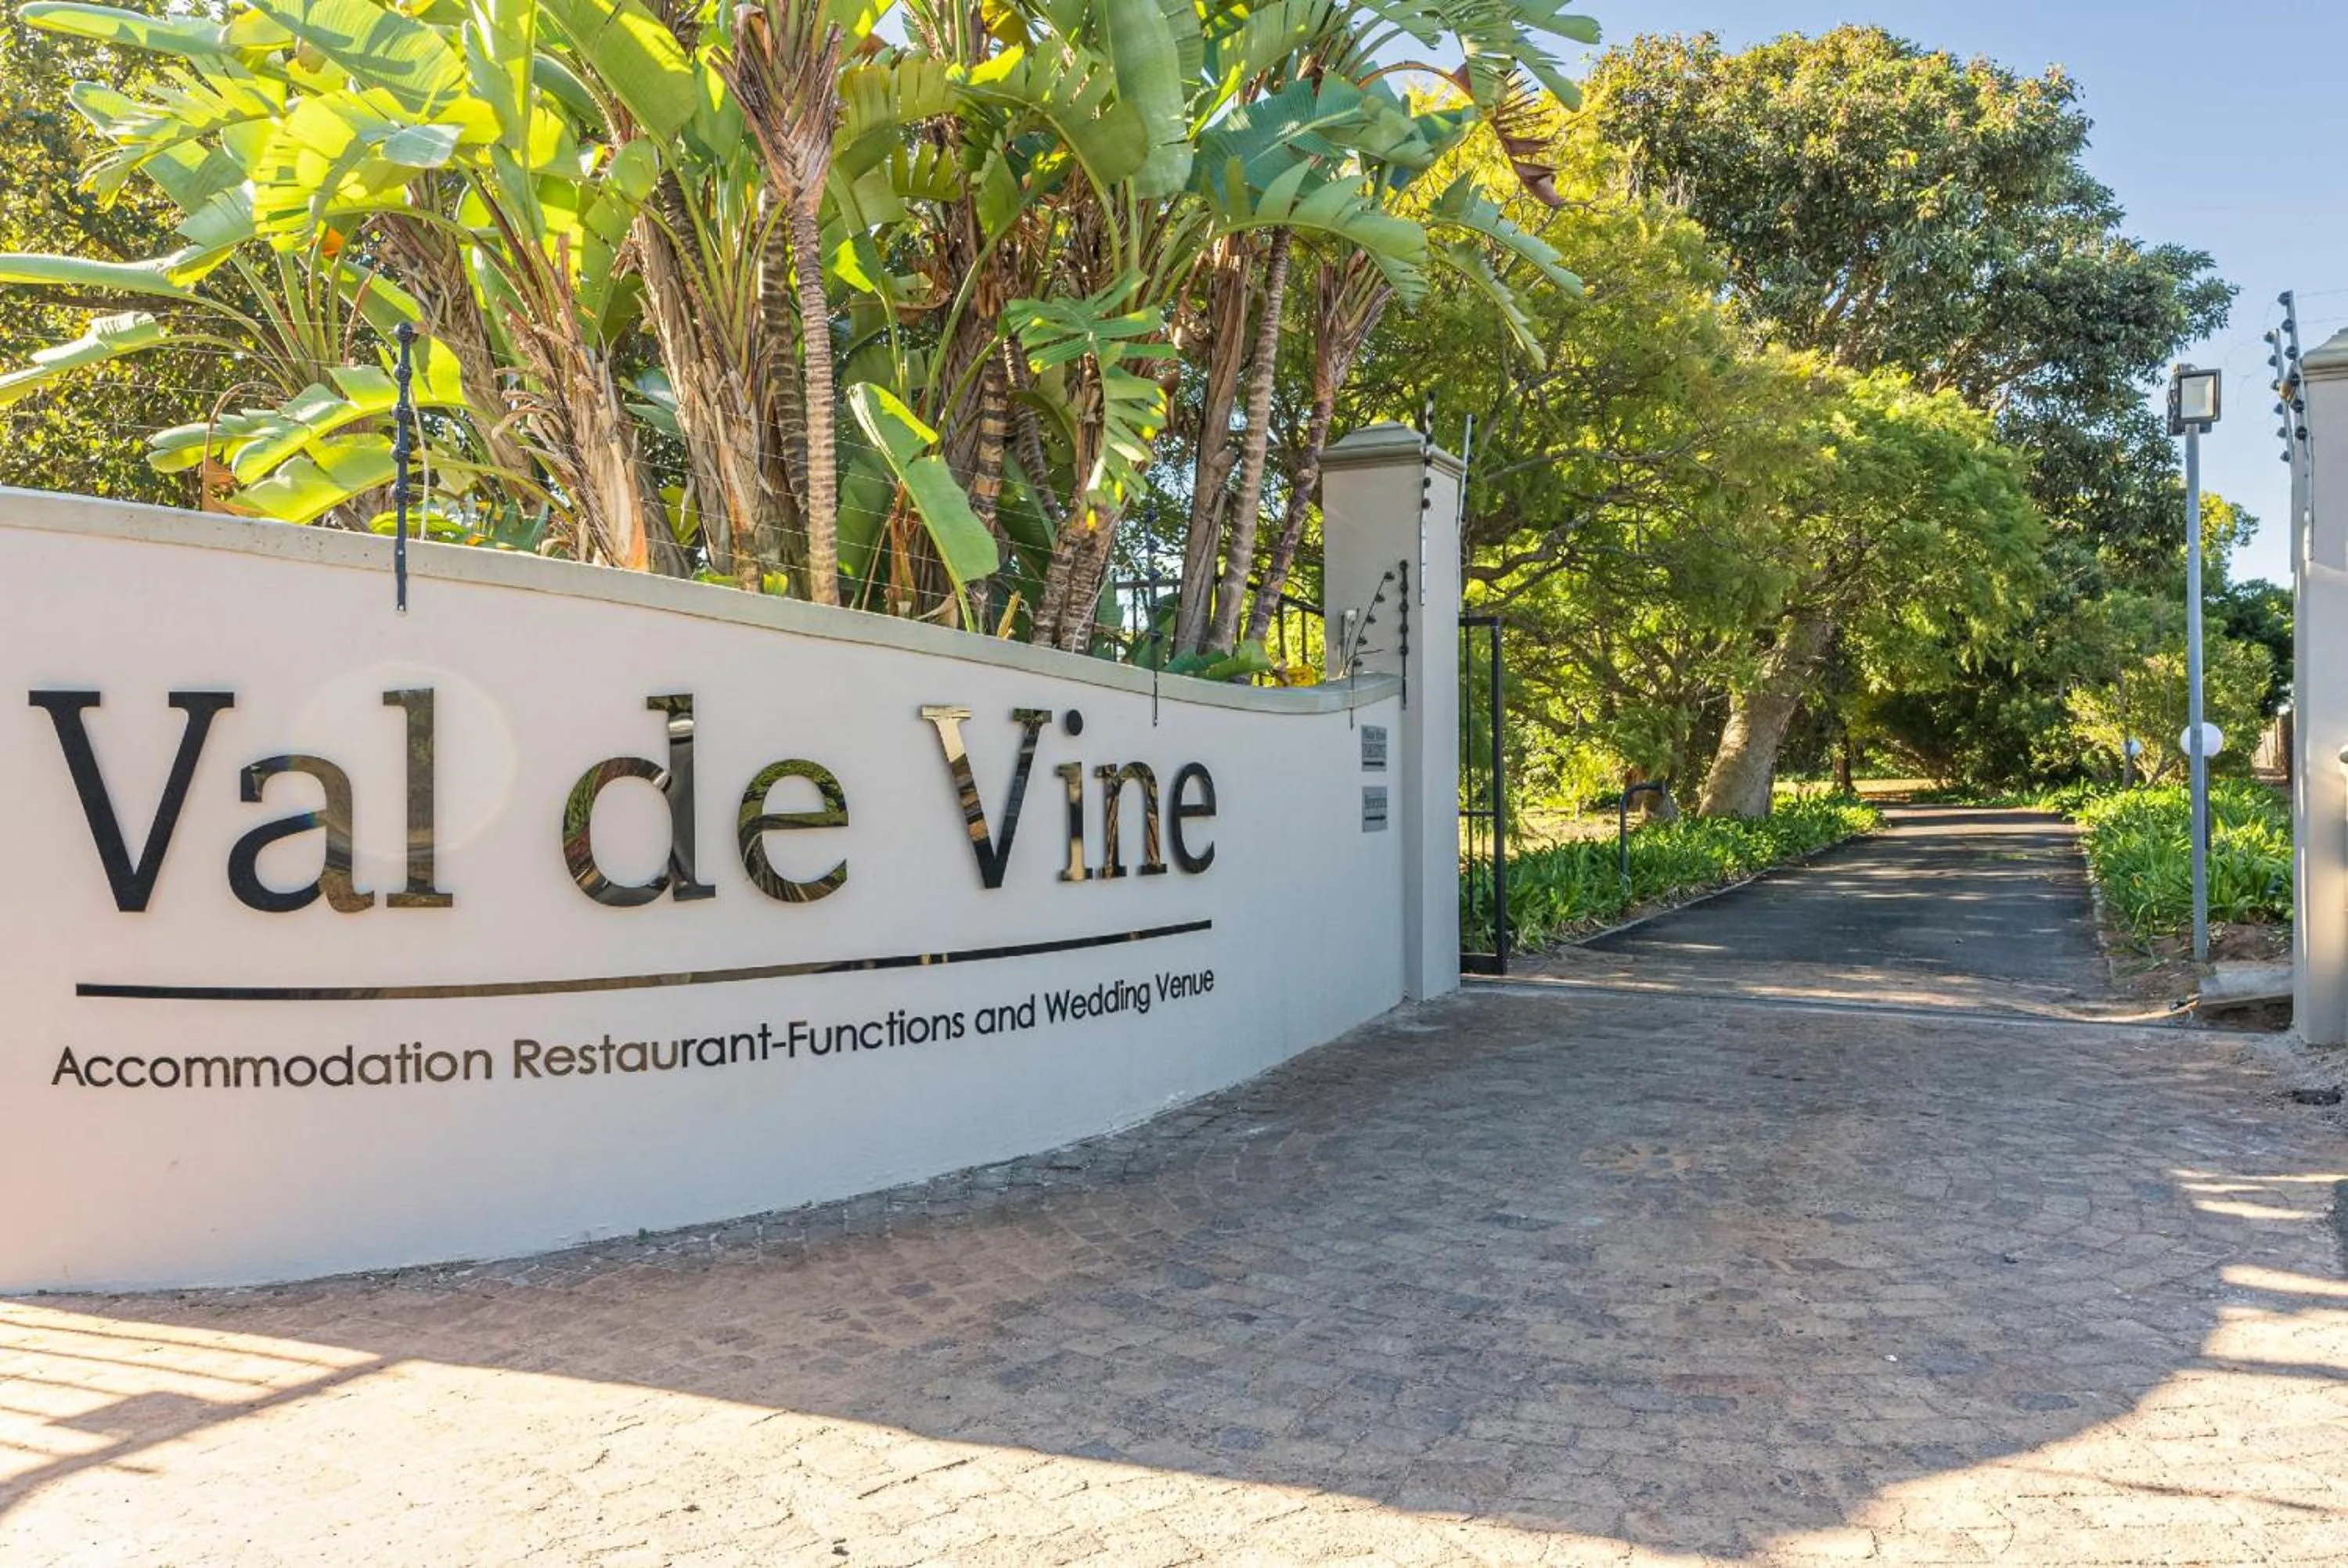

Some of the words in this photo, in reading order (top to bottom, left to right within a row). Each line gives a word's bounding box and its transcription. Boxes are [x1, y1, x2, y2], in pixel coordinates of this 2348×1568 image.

[28, 687, 453, 912] Val
[563, 693, 849, 907] de
[920, 704, 1216, 889] Vine
[52, 1042, 492, 1088] Accommodation
[975, 994, 1036, 1034] and
[1045, 980, 1151, 1024] Wedding
[1156, 969, 1214, 1002] Venue
